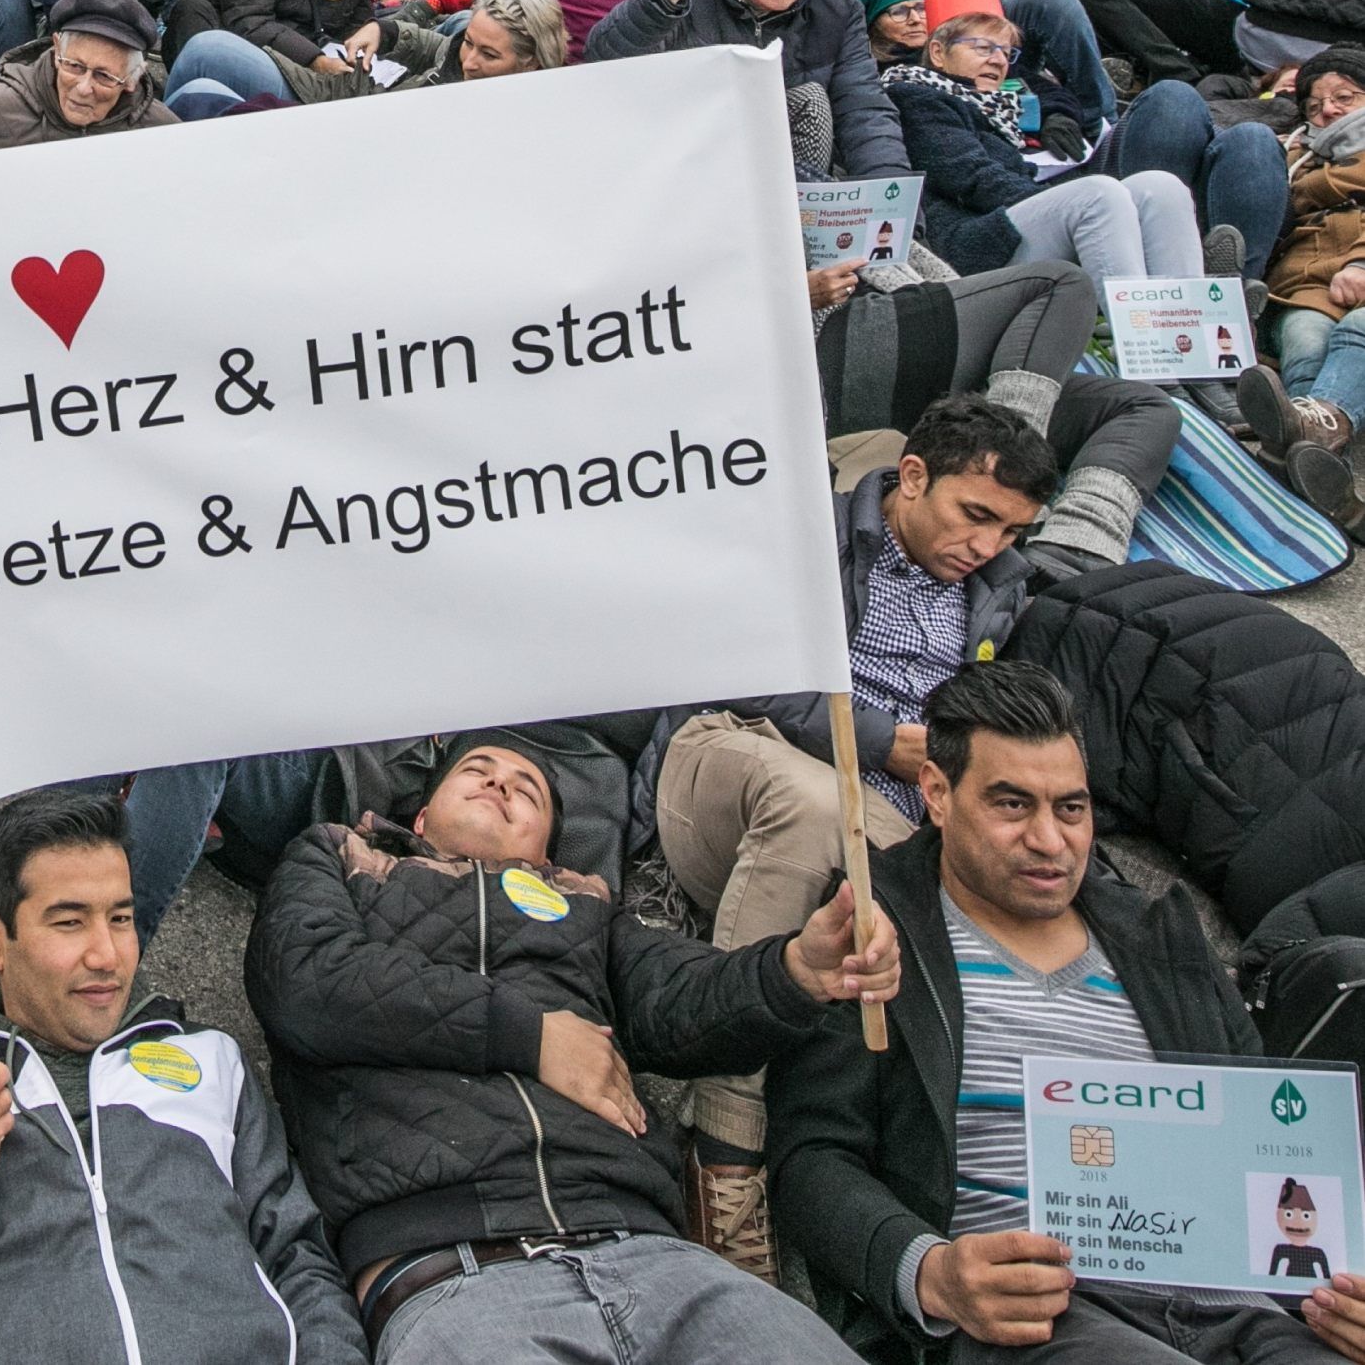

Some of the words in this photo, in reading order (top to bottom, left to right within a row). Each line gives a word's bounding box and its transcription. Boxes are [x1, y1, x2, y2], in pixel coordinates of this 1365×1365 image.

[819, 207, 873, 218] Humanitäres
[817, 217, 867, 228] Bleiberecht
[1115, 286, 1183, 302] ecard
[1150, 309, 1203, 317] Humanitäres
[1152, 320, 1201, 329] Bleiberecht
[215, 348, 274, 415] &
[307, 329, 477, 404] Hirn
[512, 286, 691, 374] statt
[198, 495, 252, 557] &
[276, 430, 766, 553] Angstmache
[1043, 1079, 1205, 1112] ecard
[1255, 1144, 1281, 1157] 1511
[1285, 1145, 1313, 1158] 2018
[1079, 1170, 1108, 1183] 2018
[1045, 1191, 1072, 1207] Mir
[1076, 1193, 1102, 1209] sin
[1106, 1194, 1129, 1210] Ali
[1046, 1211, 1073, 1227] Mir
[1077, 1213, 1102, 1229] sin
[1077, 1233, 1103, 1248] sin
[1107, 1235, 1183, 1255] Menscha
[1077, 1253, 1103, 1268] sin
[1108, 1258, 1119, 1271] o
[1123, 1256, 1146, 1272] do
